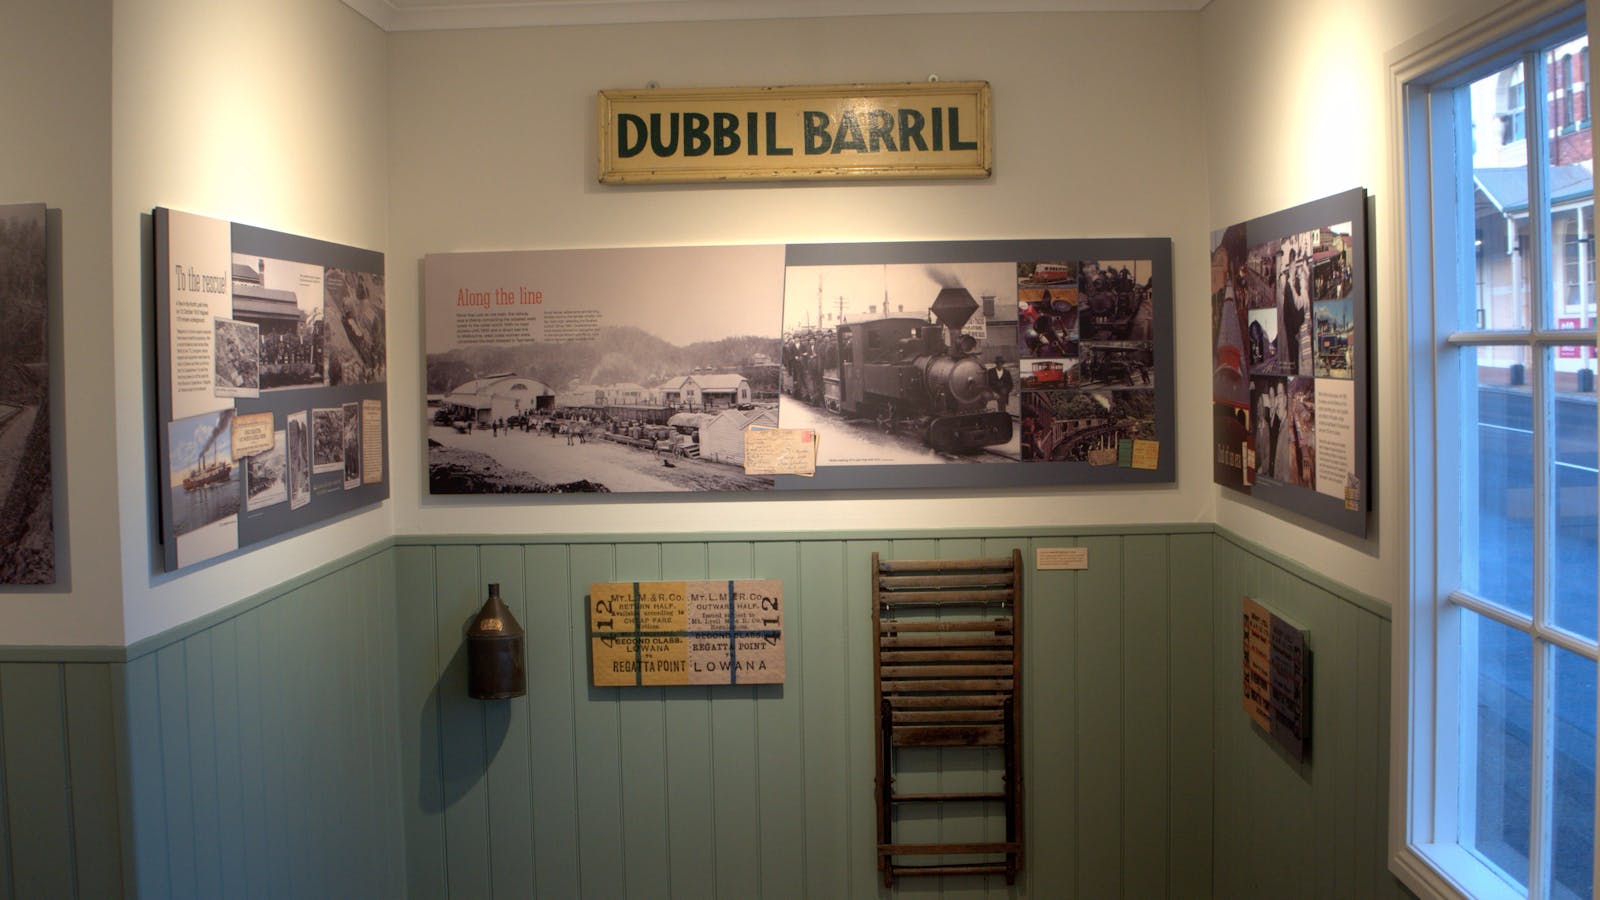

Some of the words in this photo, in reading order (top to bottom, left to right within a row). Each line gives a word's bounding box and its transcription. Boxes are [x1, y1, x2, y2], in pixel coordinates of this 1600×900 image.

[617, 111, 794, 158] DUBBIL
[803, 106, 978, 155] BARRIL
[175, 264, 187, 291] To
[188, 266, 201, 292] the
[202, 270, 227, 295] rescue!
[456, 287, 491, 309] Along
[495, 287, 515, 305] the
[519, 286, 543, 305] line
[738, 642, 767, 650] POINT
[613, 660, 656, 673] REGATTA
[657, 659, 686, 672] POINT
[694, 660, 767, 672] LOWANA
